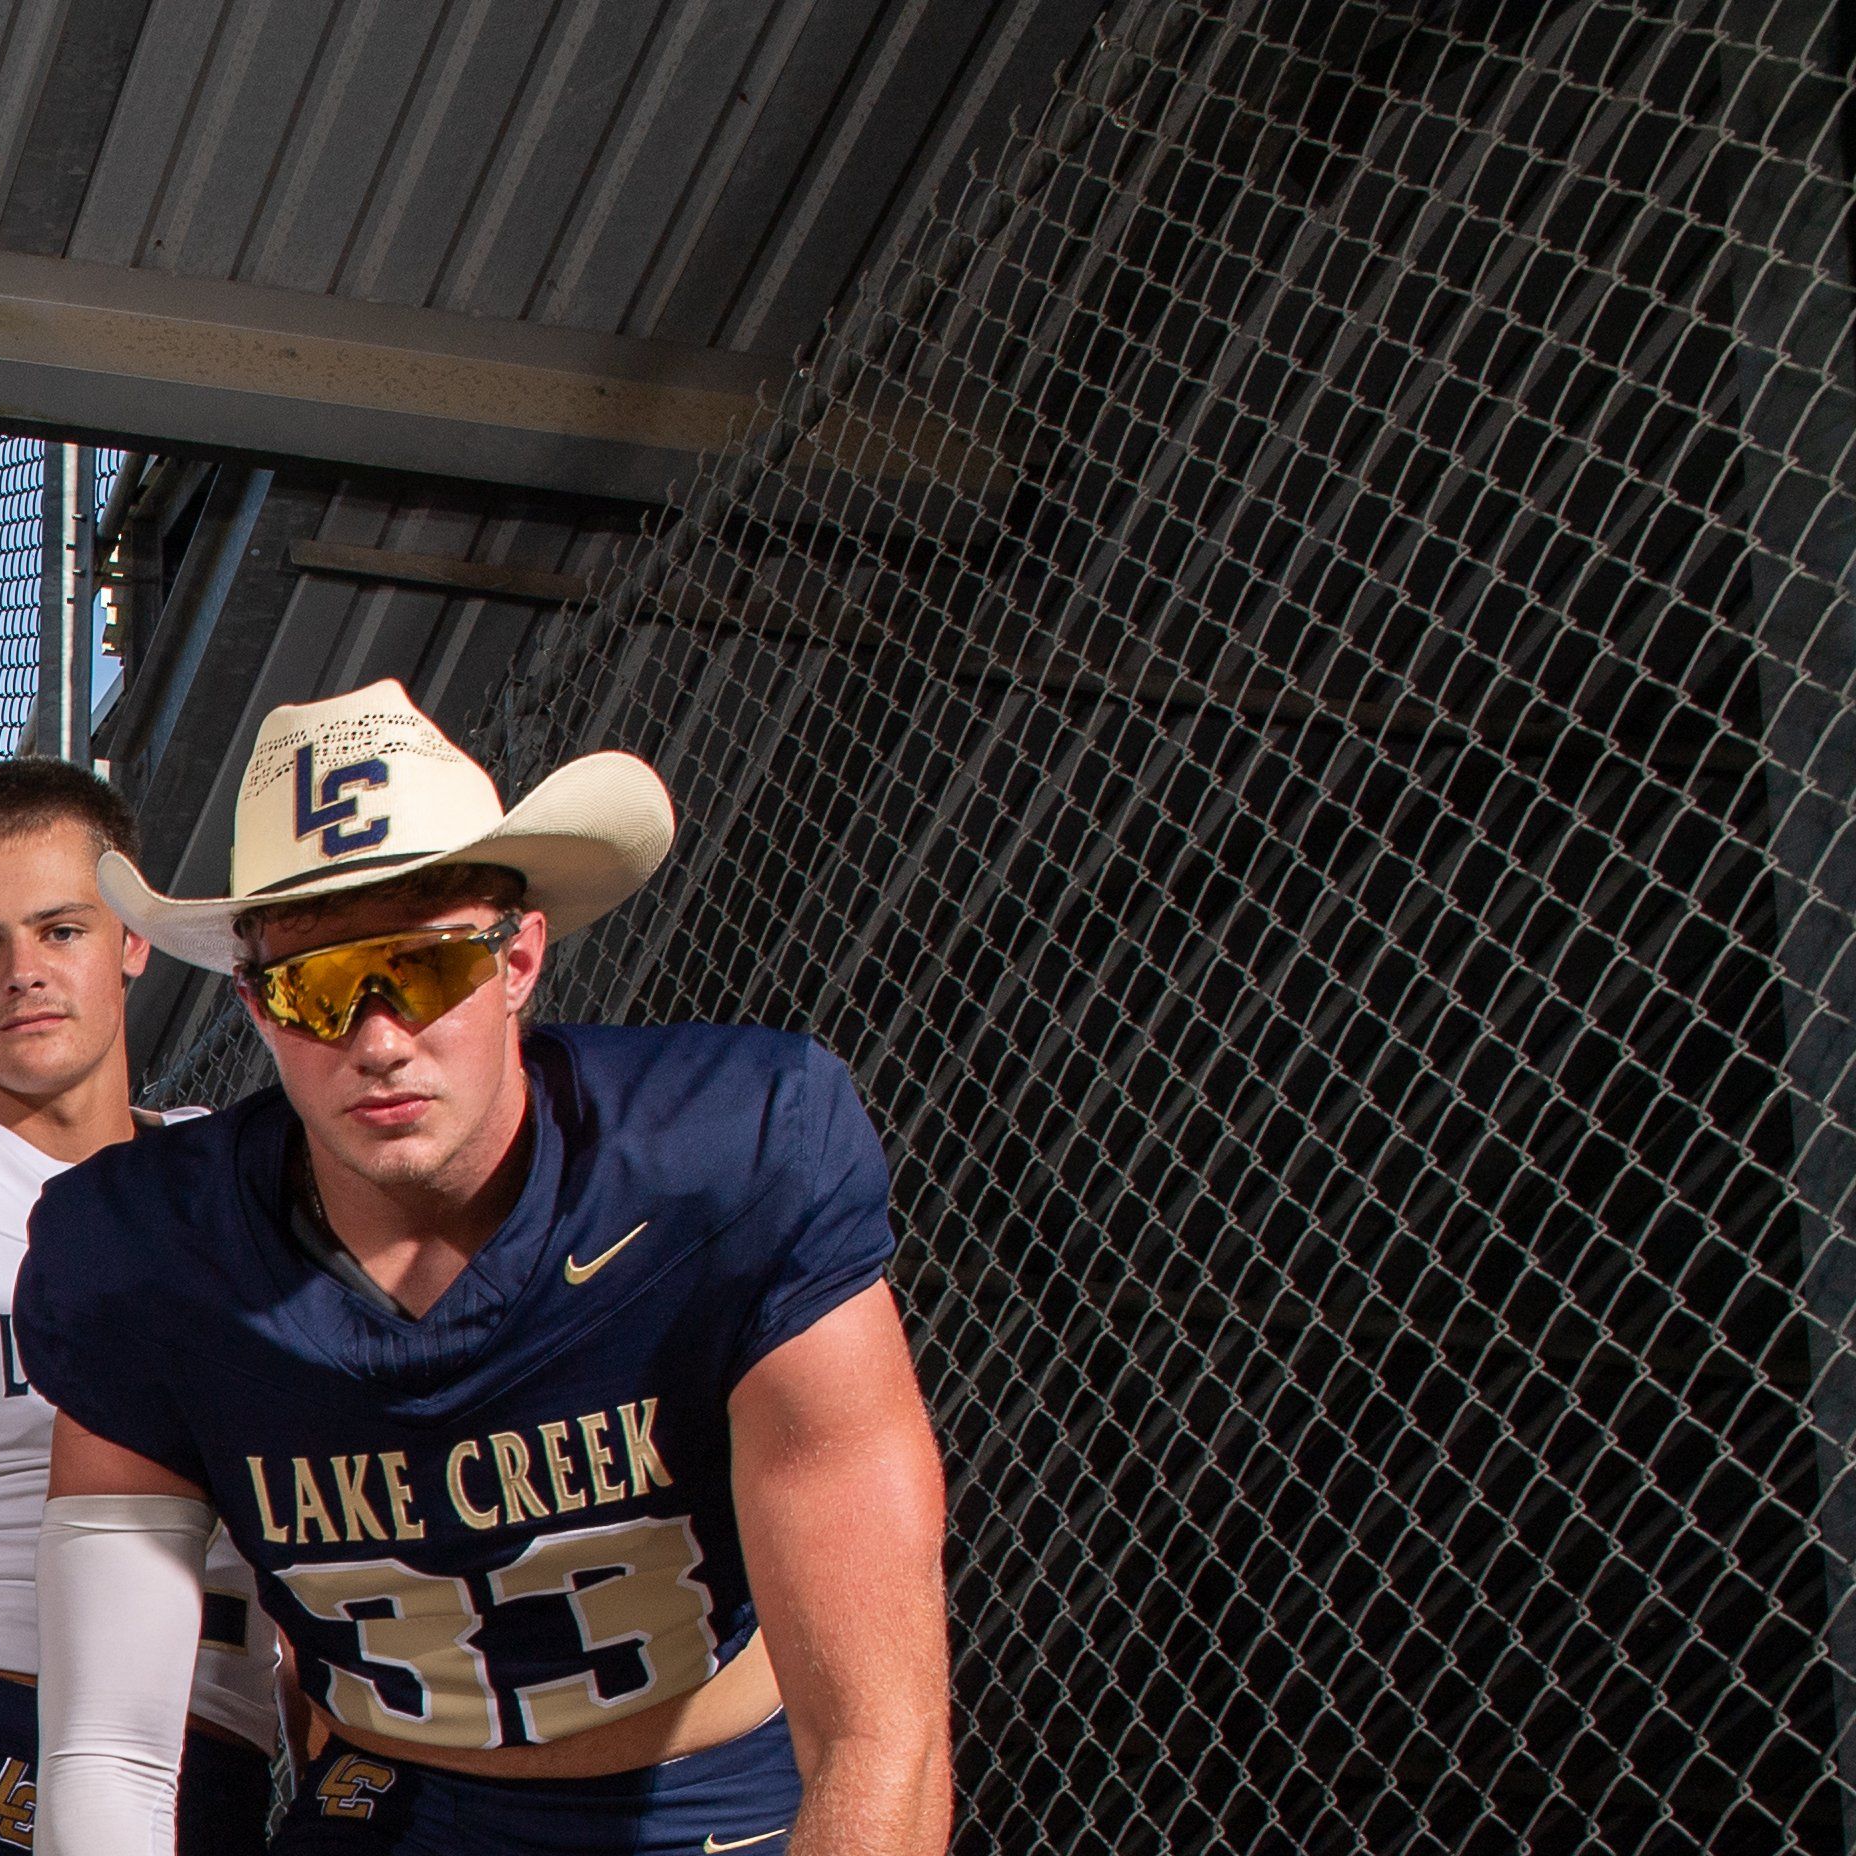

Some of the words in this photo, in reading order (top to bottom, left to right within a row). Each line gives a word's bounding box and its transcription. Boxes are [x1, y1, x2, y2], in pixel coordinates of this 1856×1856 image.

[292, 742, 390, 860] LC
[246, 1451, 426, 1544] LAKE
[446, 1397, 674, 1531] CREEK
[272, 1515, 720, 1749] 33
